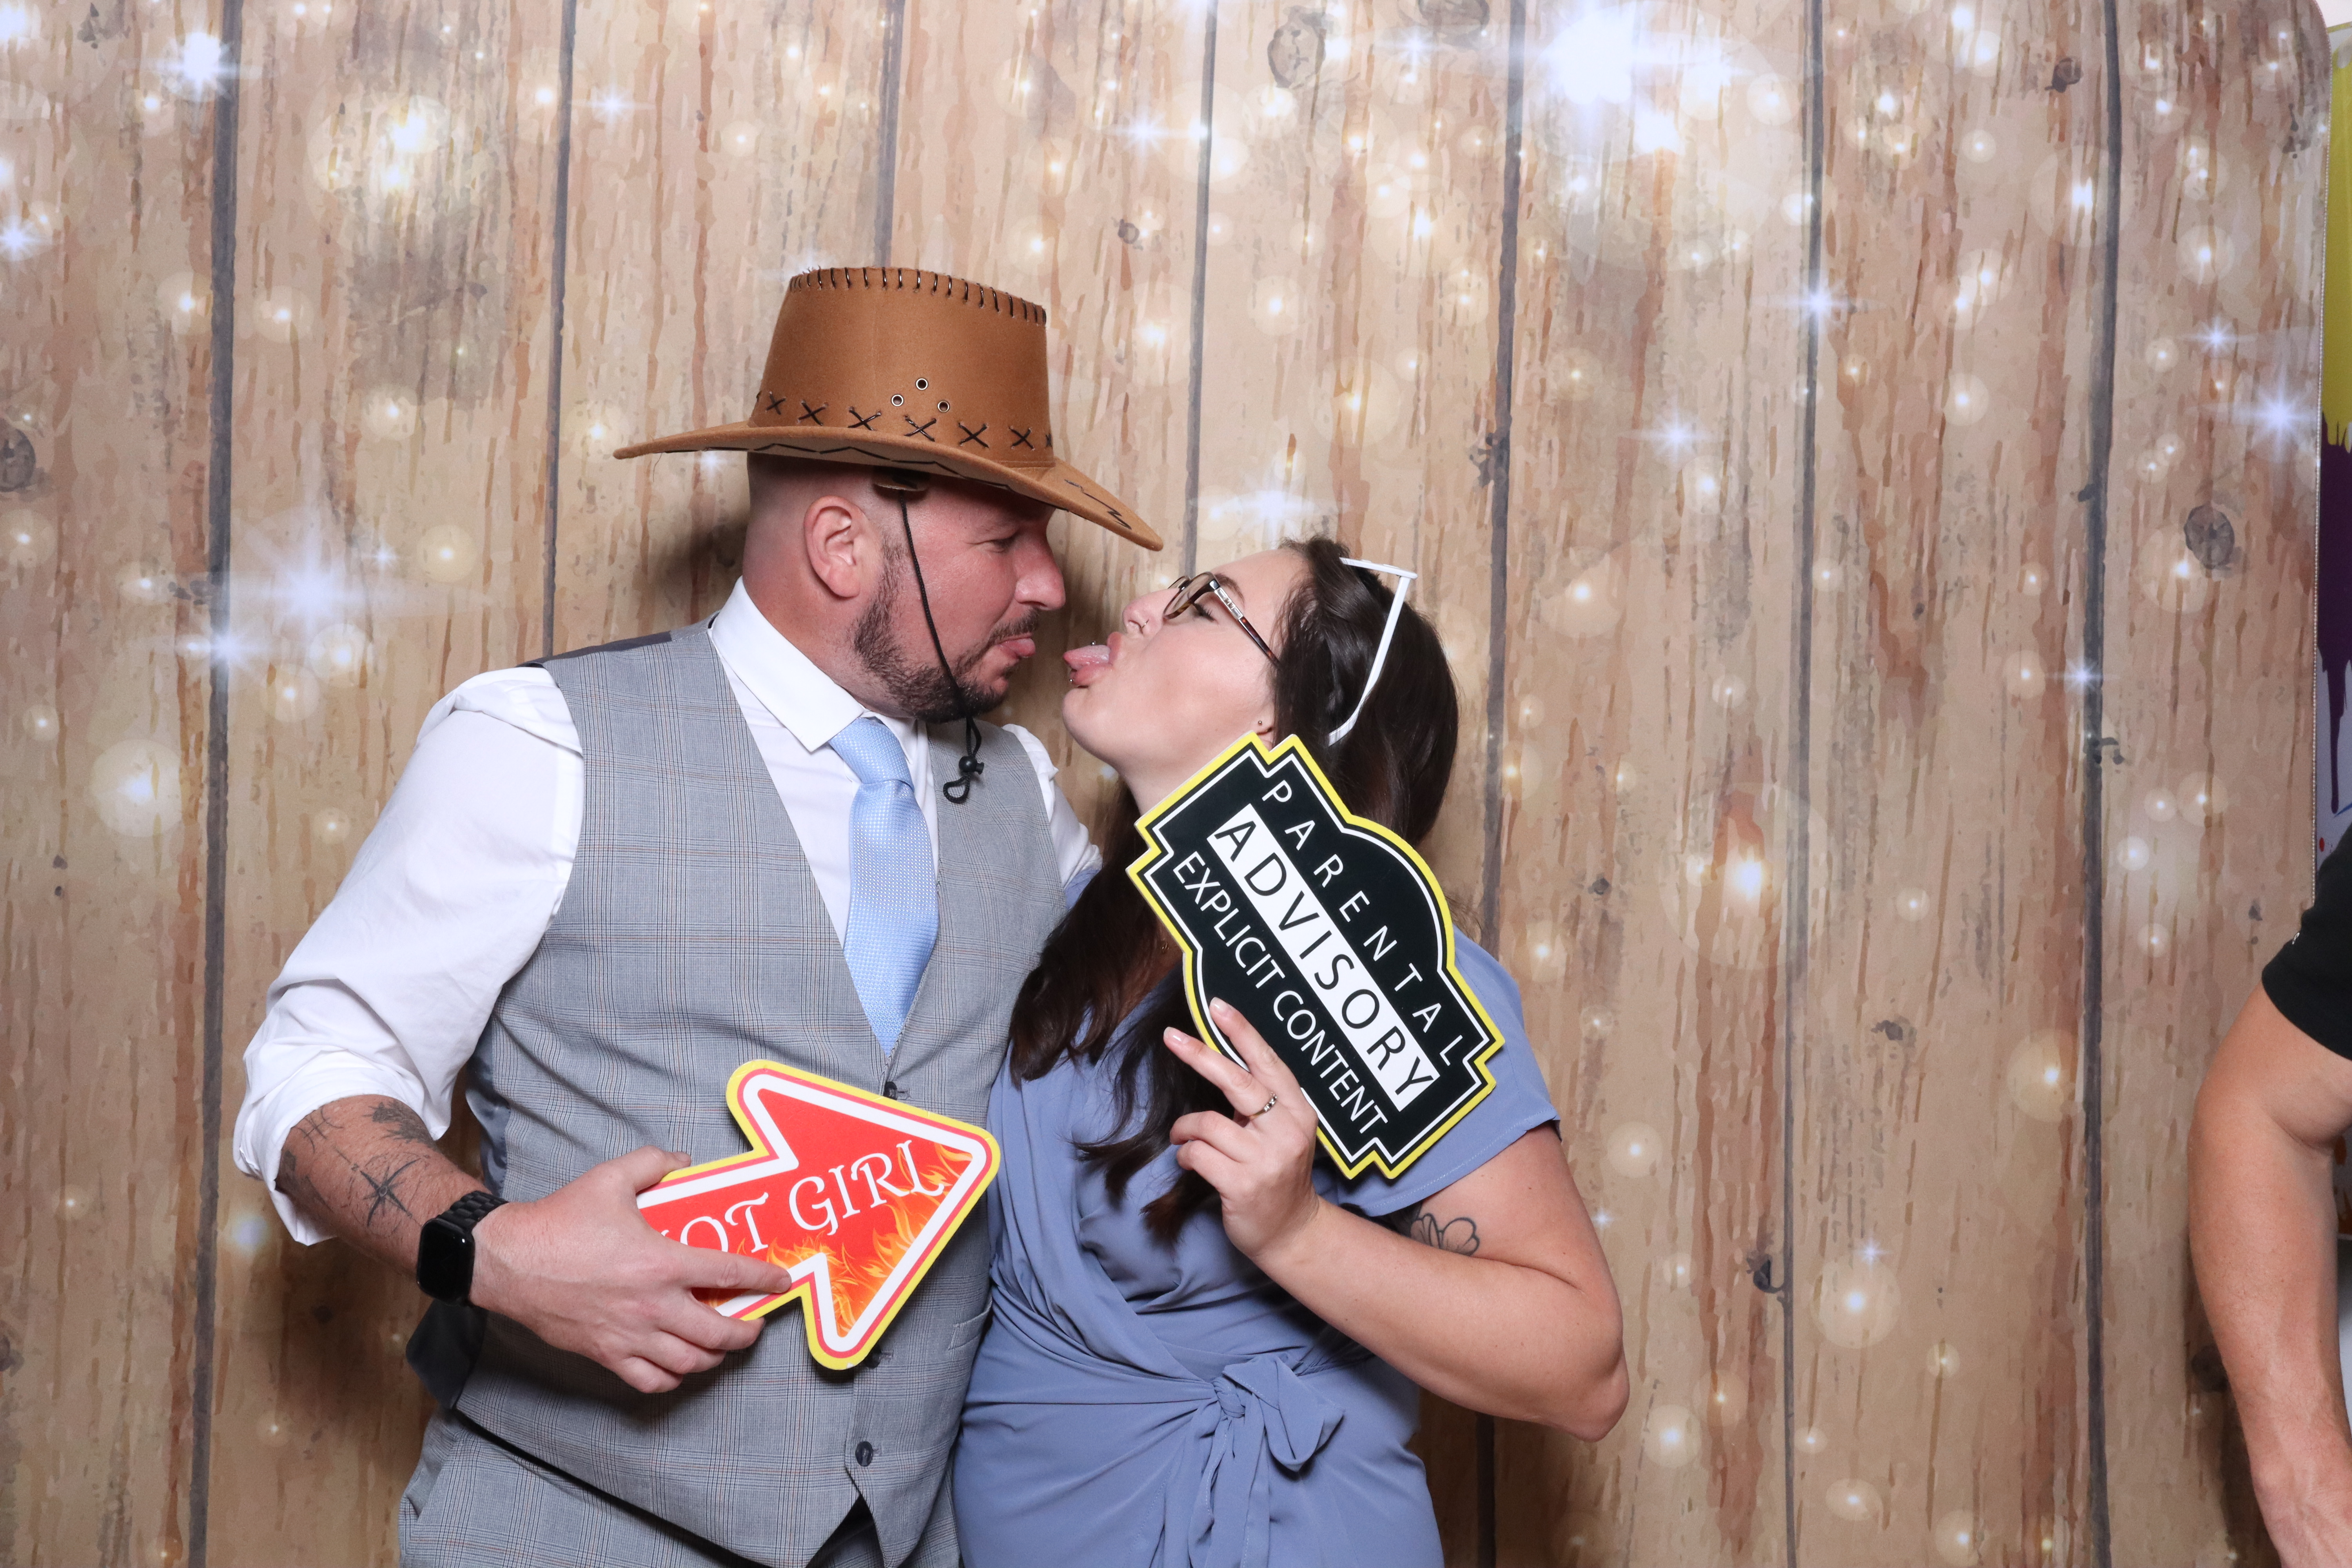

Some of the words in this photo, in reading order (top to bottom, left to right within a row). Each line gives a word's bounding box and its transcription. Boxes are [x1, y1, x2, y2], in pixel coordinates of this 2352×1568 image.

[1172, 851, 1285, 989] EXPLICIT
[1273, 990, 1388, 1134] CONTENT
[1214, 820, 1434, 1095] ADVISORY
[1261, 779, 1463, 1066] PARENTAL
[661, 1192, 769, 1253] OT
[789, 1140, 944, 1236] GIRL
